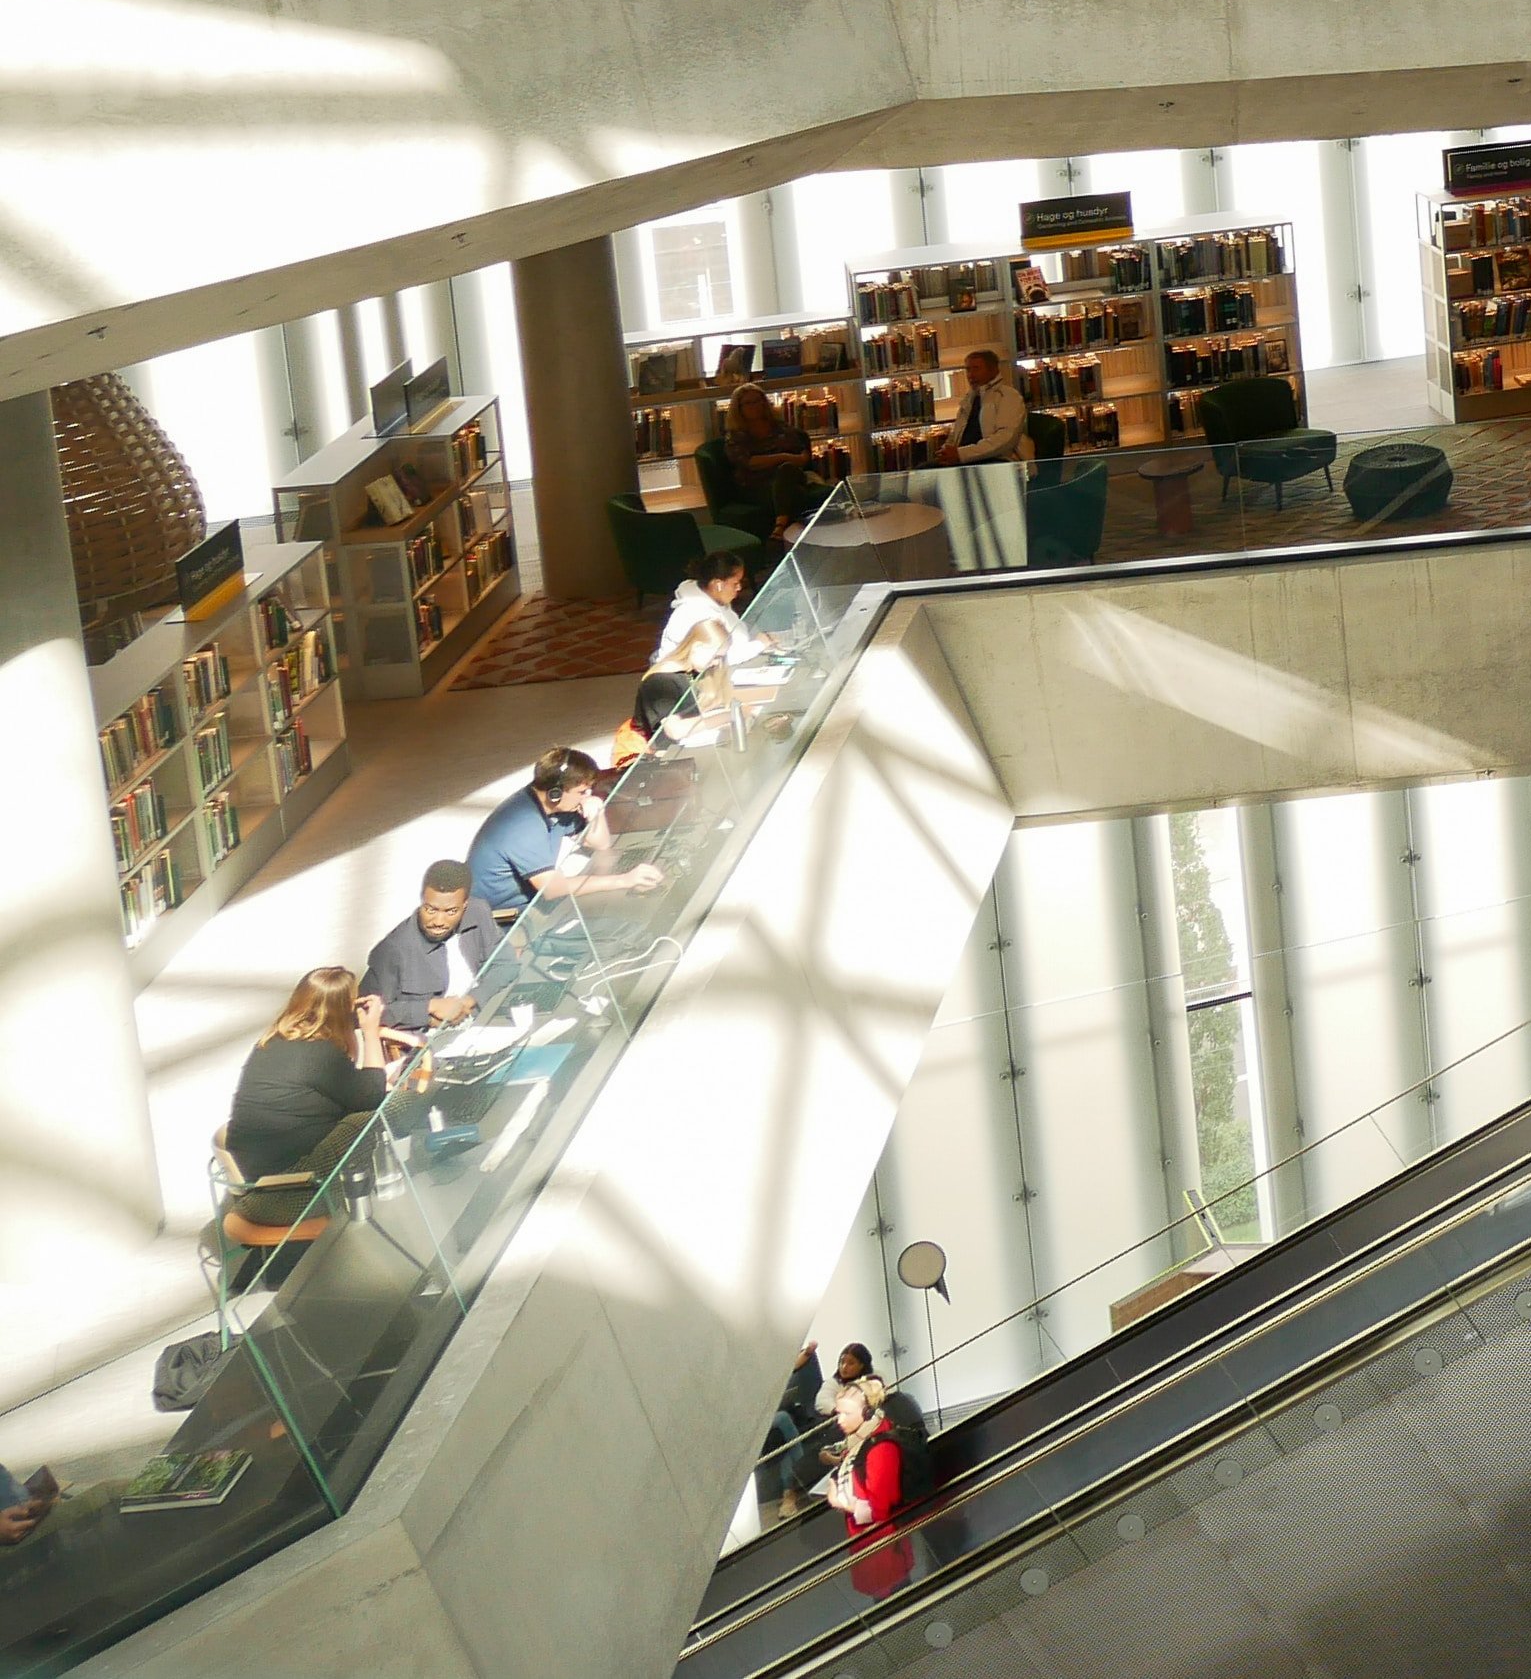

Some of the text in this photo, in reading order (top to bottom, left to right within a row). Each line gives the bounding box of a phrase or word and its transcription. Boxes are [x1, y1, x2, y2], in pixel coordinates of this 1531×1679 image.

[1037, 206, 1109, 223] Hage og husdyr
